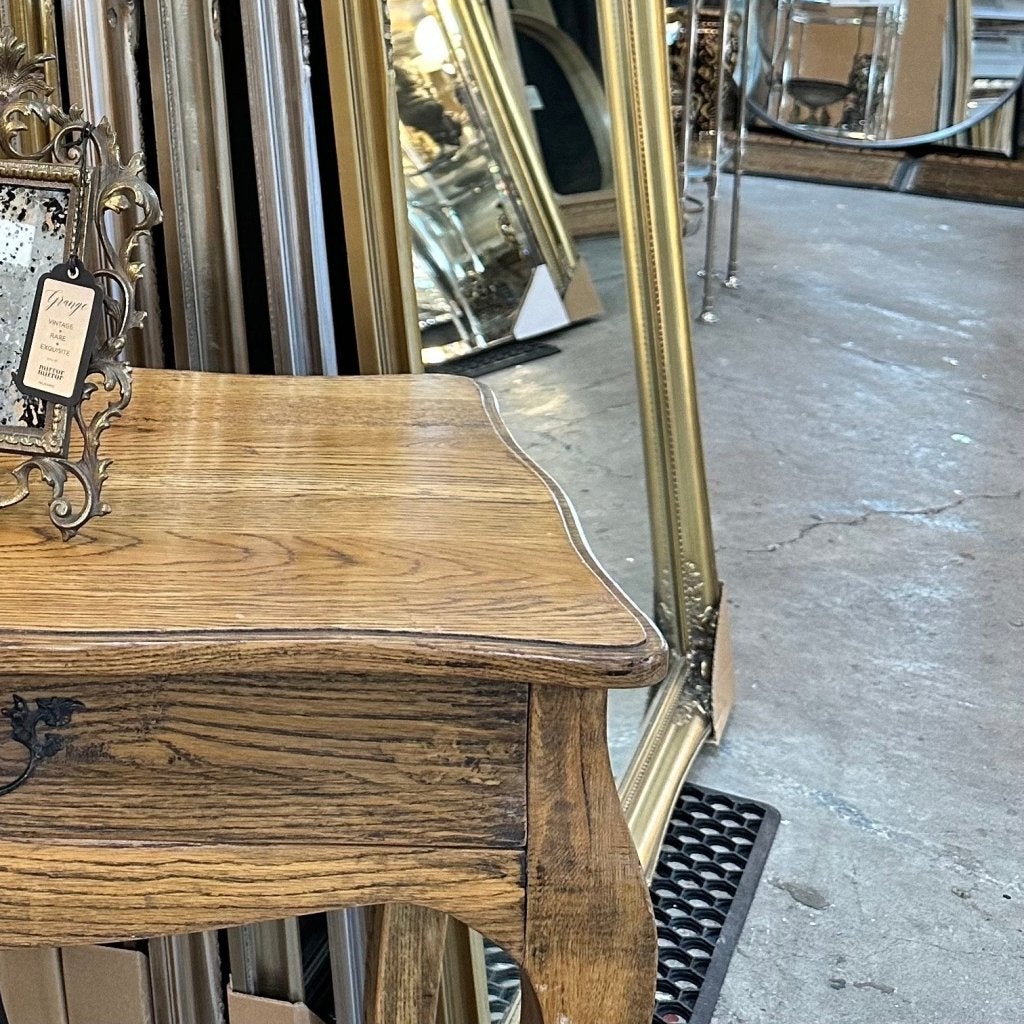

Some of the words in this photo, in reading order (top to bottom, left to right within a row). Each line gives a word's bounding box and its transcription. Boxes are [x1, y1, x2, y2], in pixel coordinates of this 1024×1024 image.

[46, 289, 88, 316] Grange
[48, 319, 74, 330] VINTAGE
[50, 332, 66, 342] RARE
[39, 344, 71, 357] EXQUISITE
